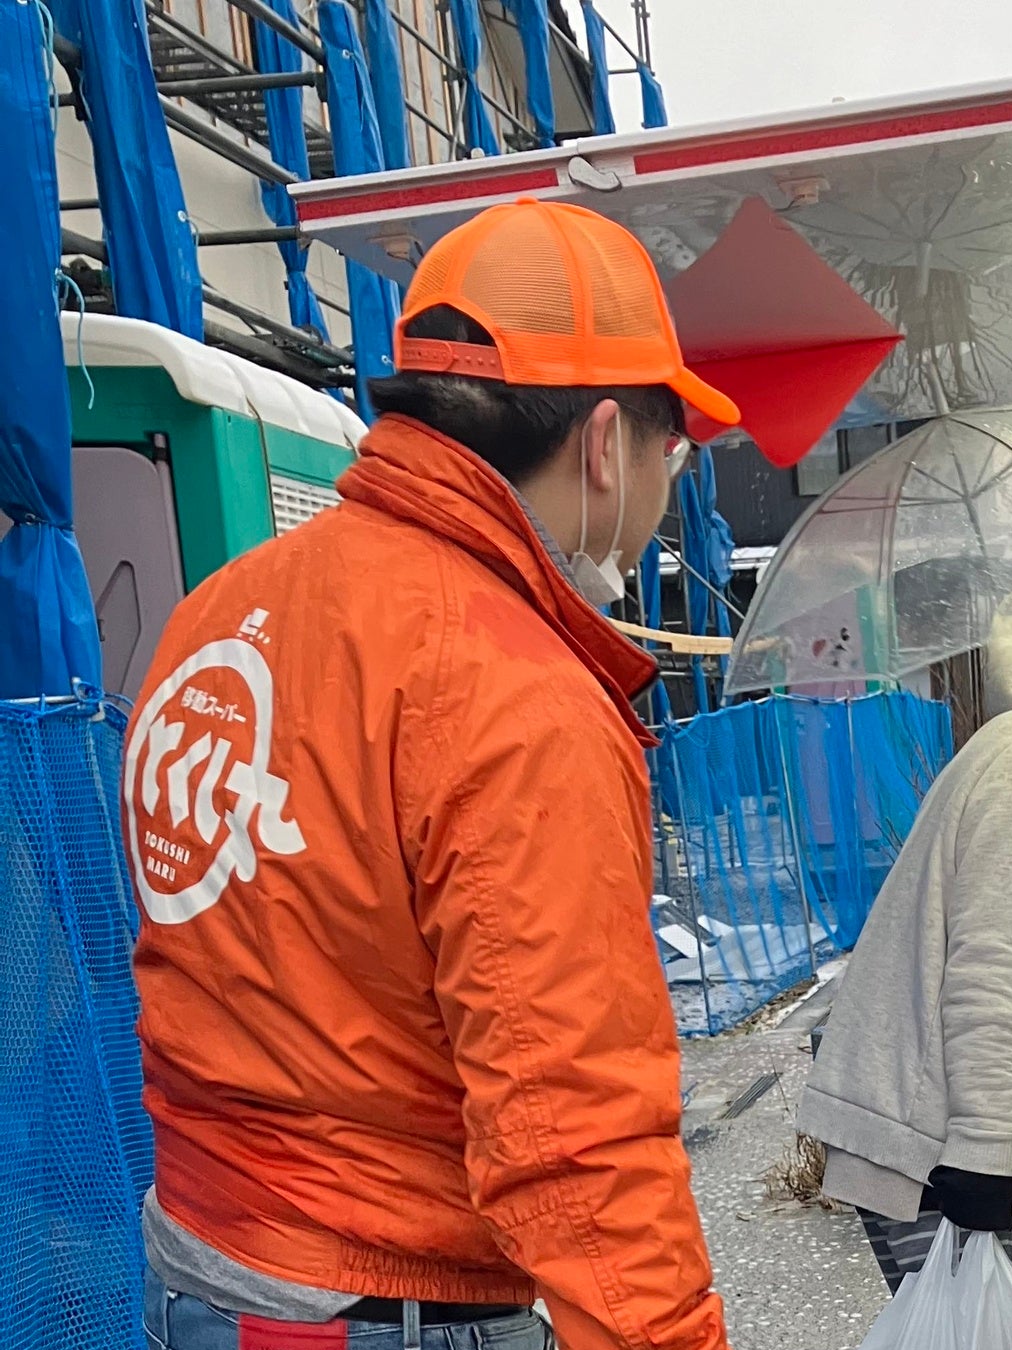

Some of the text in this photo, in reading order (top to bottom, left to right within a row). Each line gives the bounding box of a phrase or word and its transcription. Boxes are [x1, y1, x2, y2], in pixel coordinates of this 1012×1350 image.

[181, 686, 247, 723] 移動スーパー
[145, 830, 190, 865] TOKUSHI
[146, 855, 176, 882] MARU
